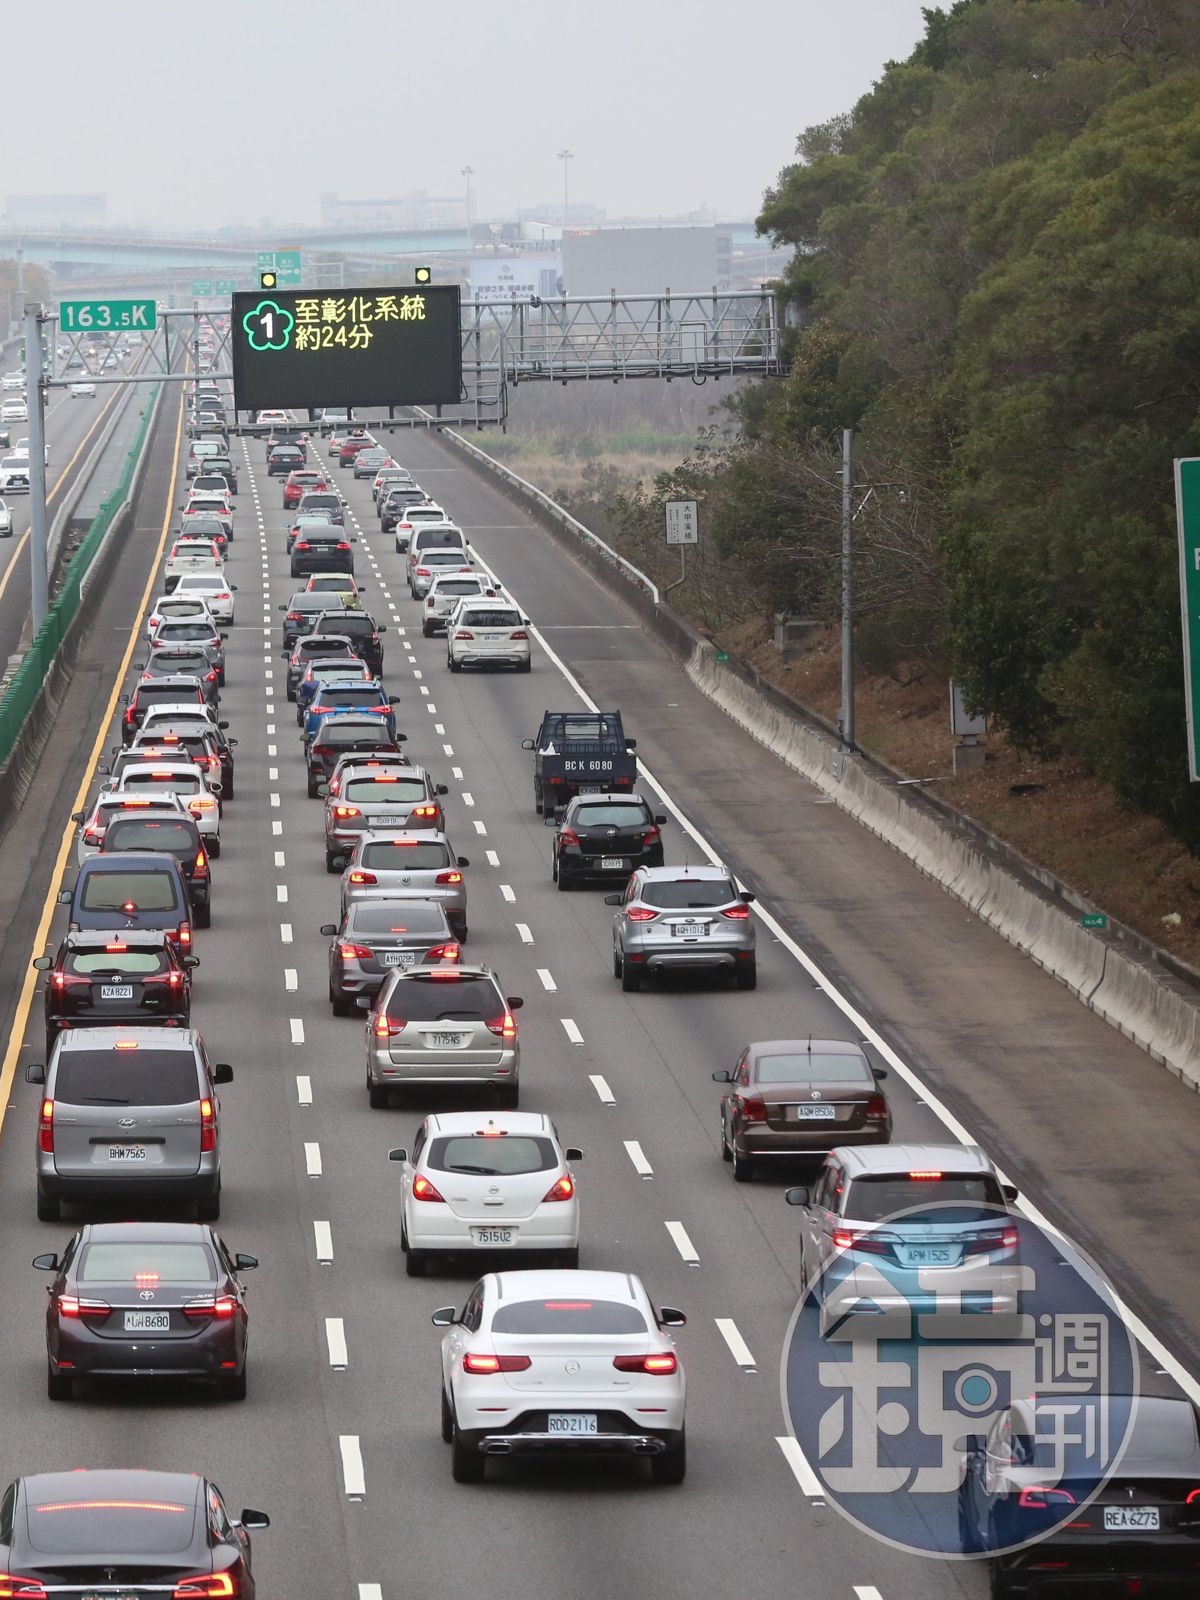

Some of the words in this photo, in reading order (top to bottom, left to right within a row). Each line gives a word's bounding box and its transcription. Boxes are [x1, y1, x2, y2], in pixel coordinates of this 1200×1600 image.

[67, 304, 148, 327] 163.5K
[295, 294, 426, 324] 至彰化系統
[260, 312, 274, 339] 1
[295, 323, 373, 351] 約24分
